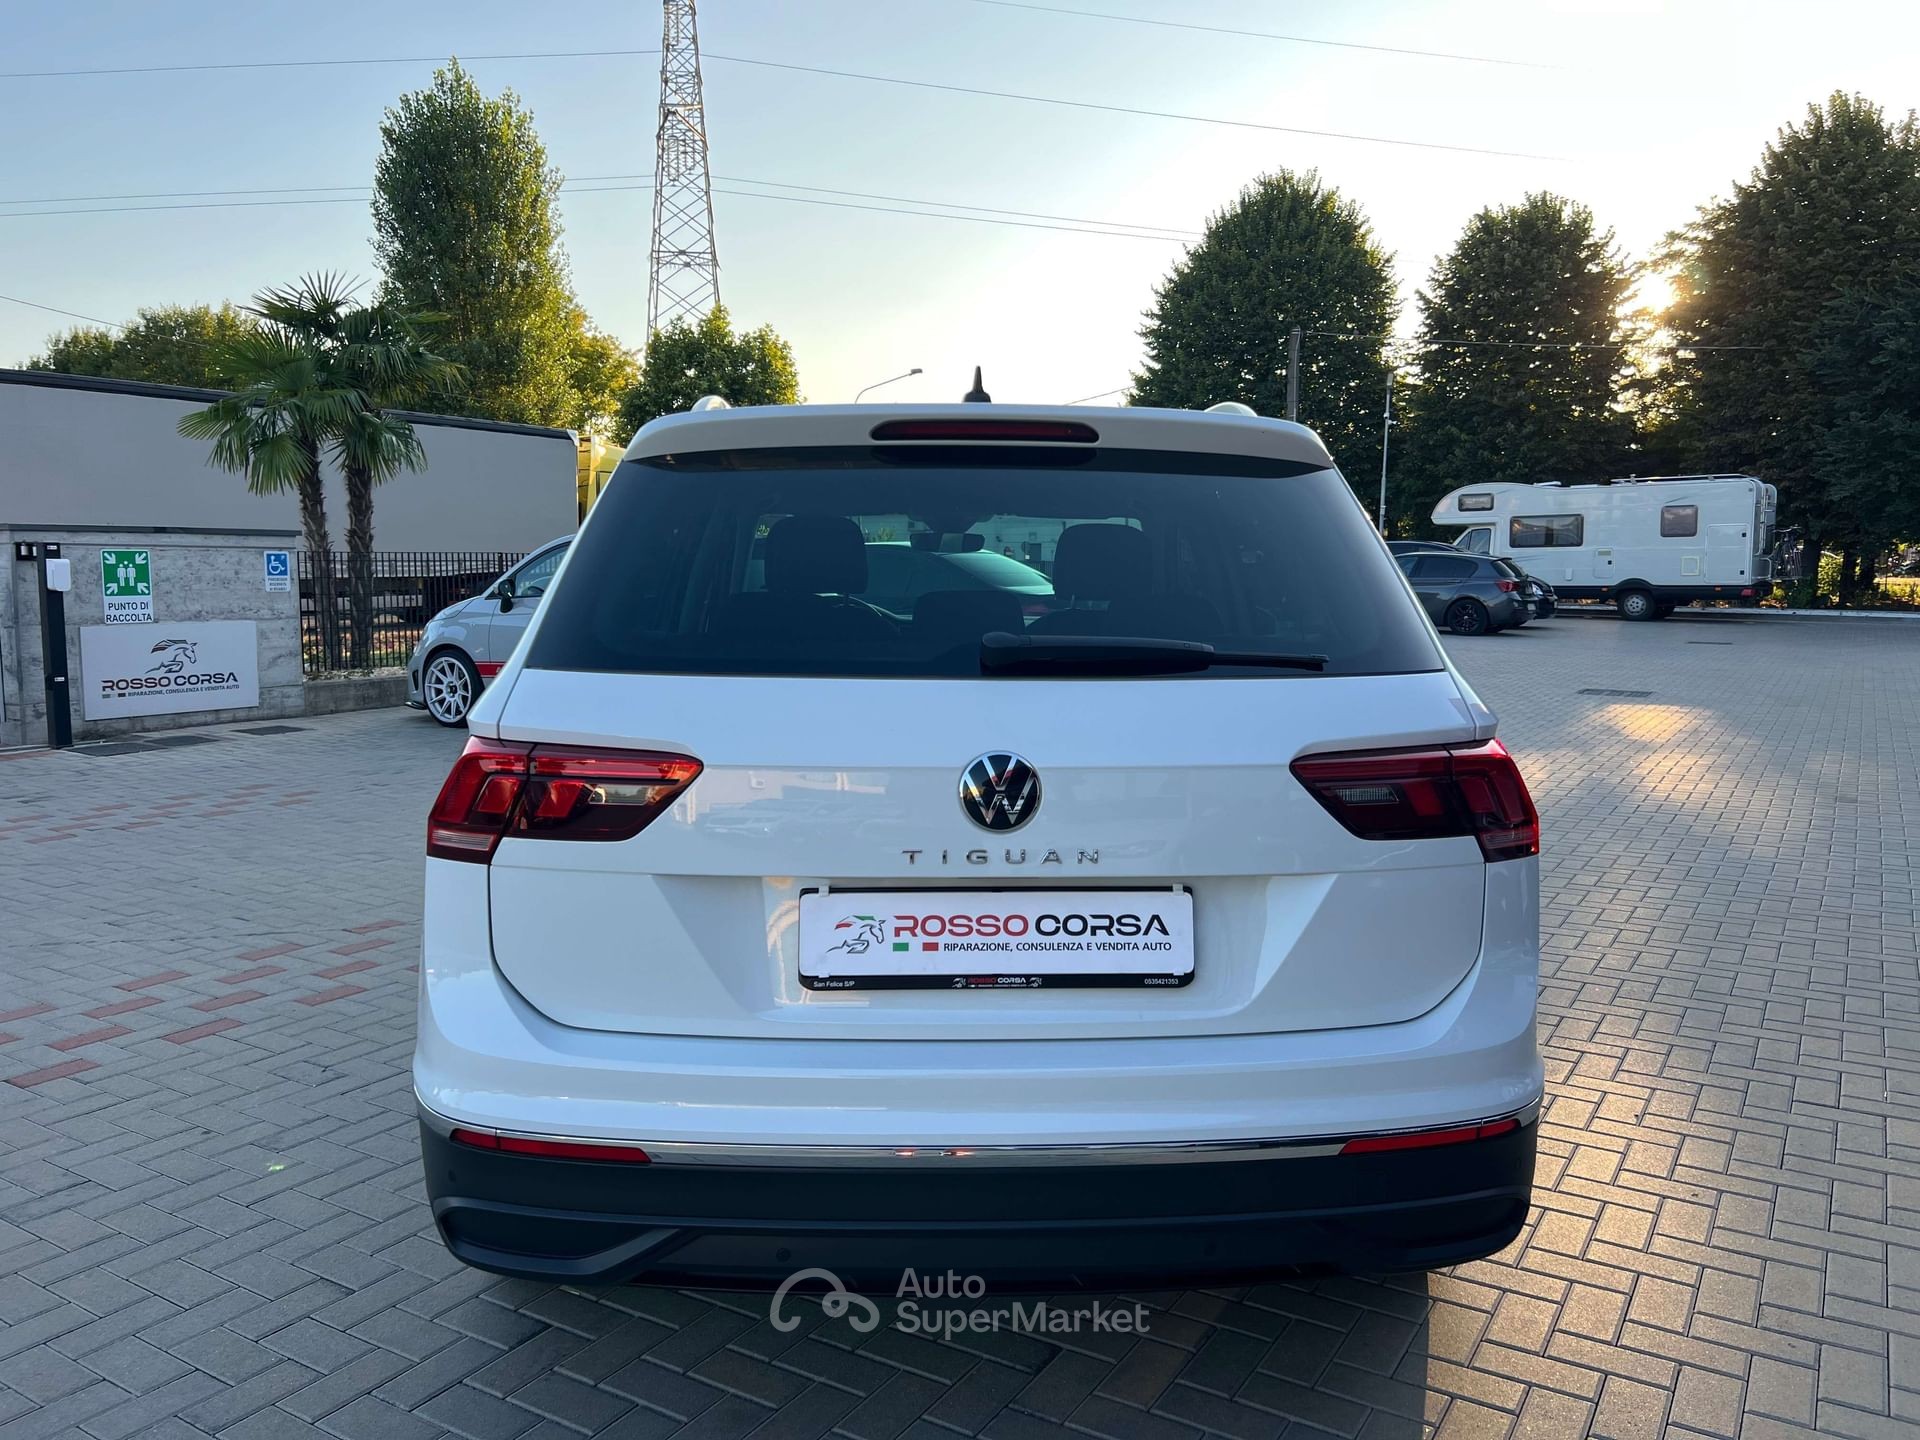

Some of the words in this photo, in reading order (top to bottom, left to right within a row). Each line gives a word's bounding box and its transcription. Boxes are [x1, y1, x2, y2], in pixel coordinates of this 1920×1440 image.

[108, 602, 138, 611] PUNTO
[140, 601, 149, 610] DI
[106, 613, 152, 623] RACCOLTA
[101, 676, 171, 692] ROSSO
[174, 672, 239, 687] CORSA
[902, 849, 1100, 865] TIGUAN
[893, 914, 1029, 937] ROSSO
[1035, 914, 1170, 937] CORSA
[943, 942, 1013, 952] RIPARAZIONE,
[1016, 942, 1082, 951] CONSULENZA
[1087, 942, 1092, 951] E
[1095, 942, 1139, 951] VENDITA
[1142, 942, 1172, 951] AUTO
